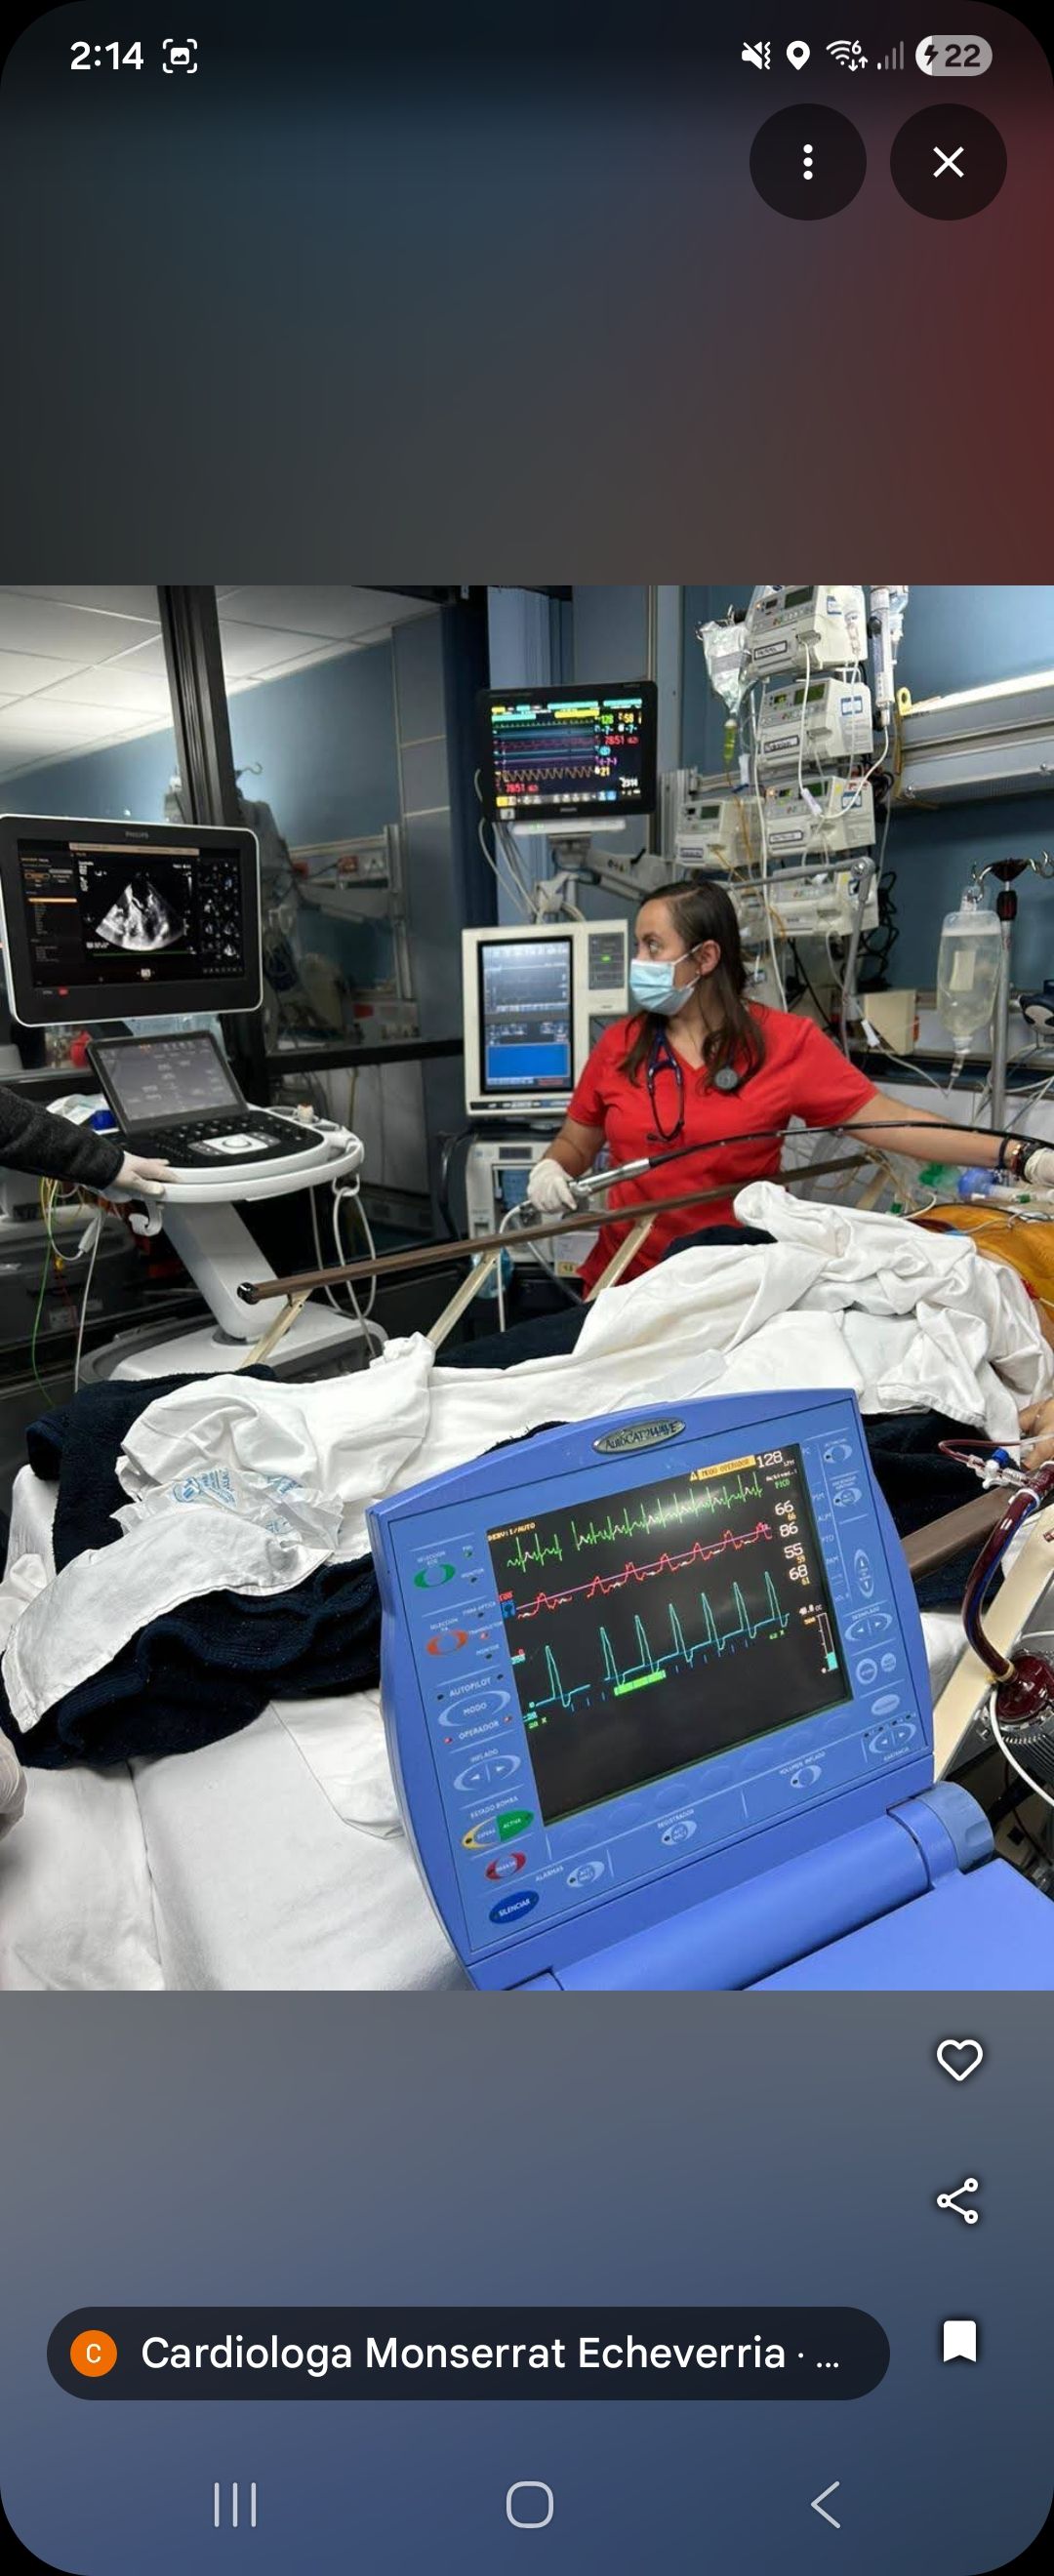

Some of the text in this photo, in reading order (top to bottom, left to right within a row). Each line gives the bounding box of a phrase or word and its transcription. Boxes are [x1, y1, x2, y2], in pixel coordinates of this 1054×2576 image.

[756, 1451, 783, 1469] 128
[775, 1501, 794, 1515] 66
[780, 1522, 798, 1537] 86
[784, 1543, 803, 1559] 55
[789, 1564, 808, 1581] 68
[449, 1677, 491, 1698] AUTOPILOT
[464, 1703, 488, 1716] MODO
[459, 1720, 500, 1740] OPERADOR
[499, 1899, 531, 1917] SILENCIAR
